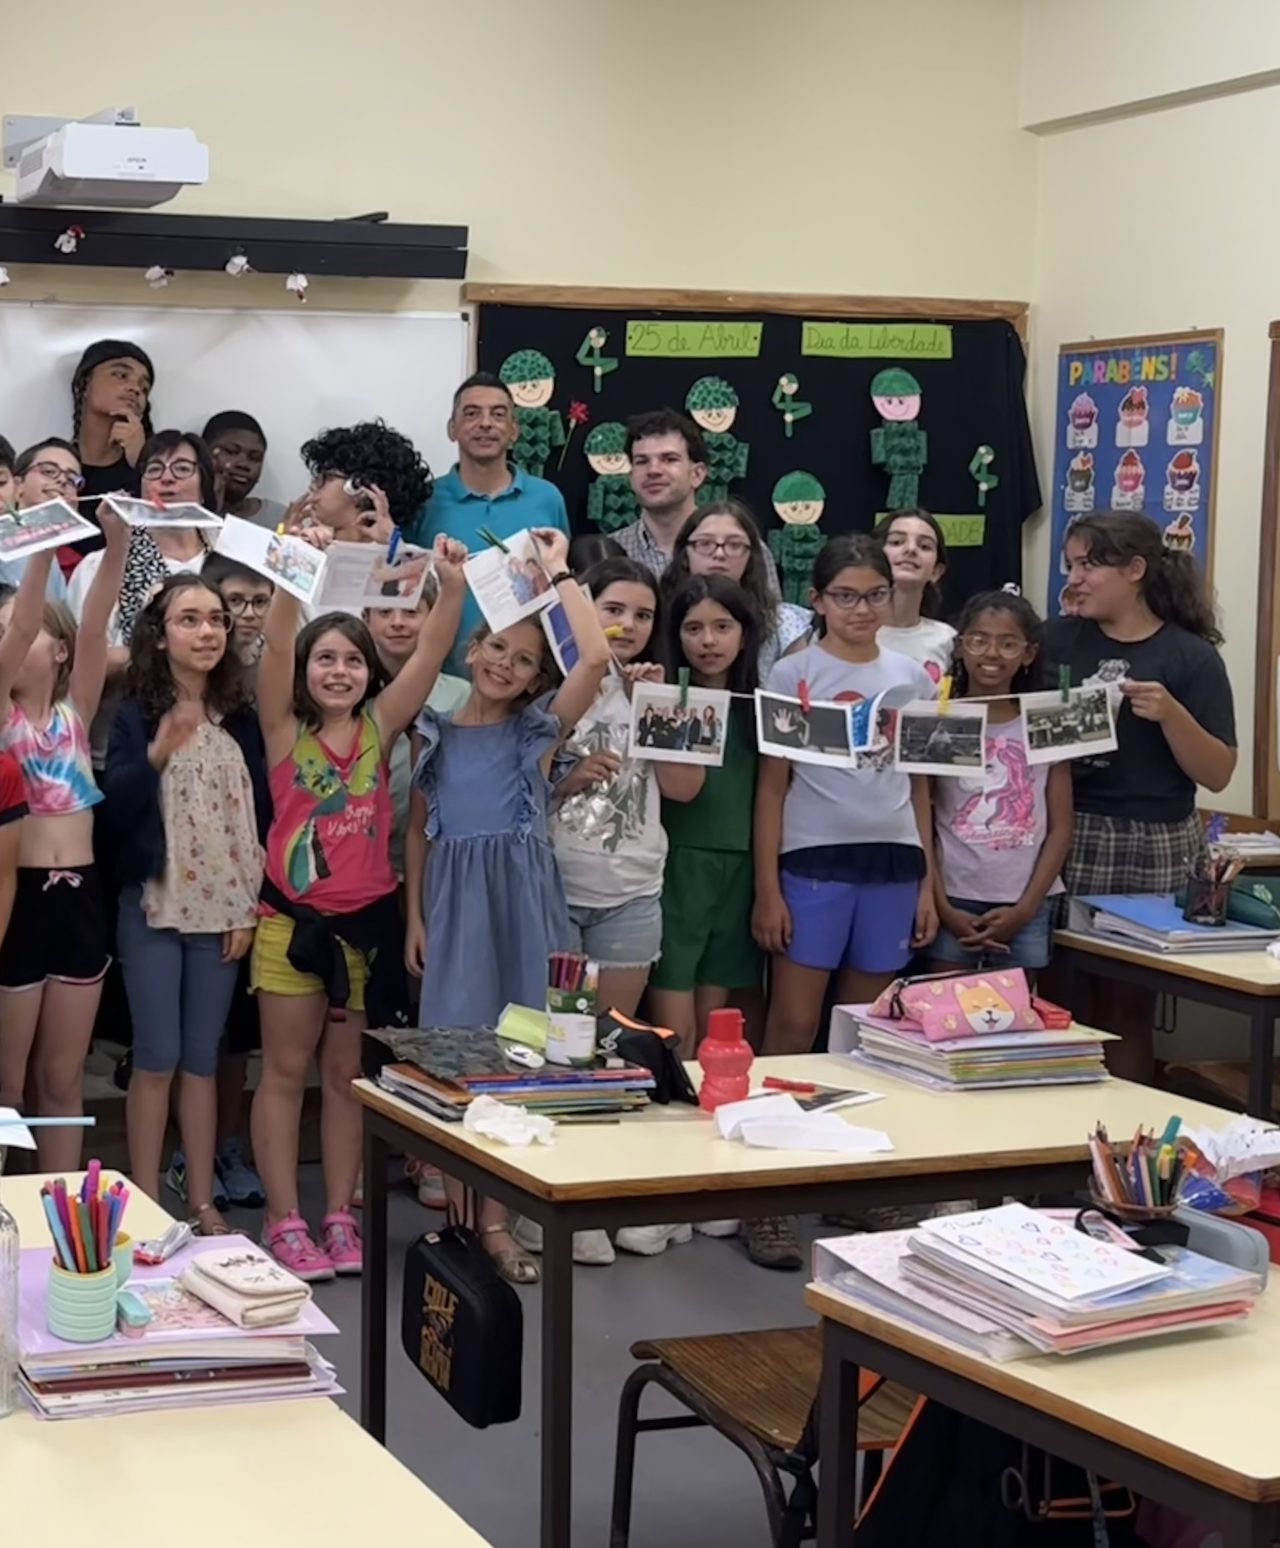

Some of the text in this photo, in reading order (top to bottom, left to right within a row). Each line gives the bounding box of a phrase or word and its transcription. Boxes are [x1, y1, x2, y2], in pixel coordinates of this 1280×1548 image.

[631, 323, 756, 352] 25 de Abril
[805, 326, 946, 352] Dia da Liberdade
[1069, 350, 1177, 386] PARABÉNS!
